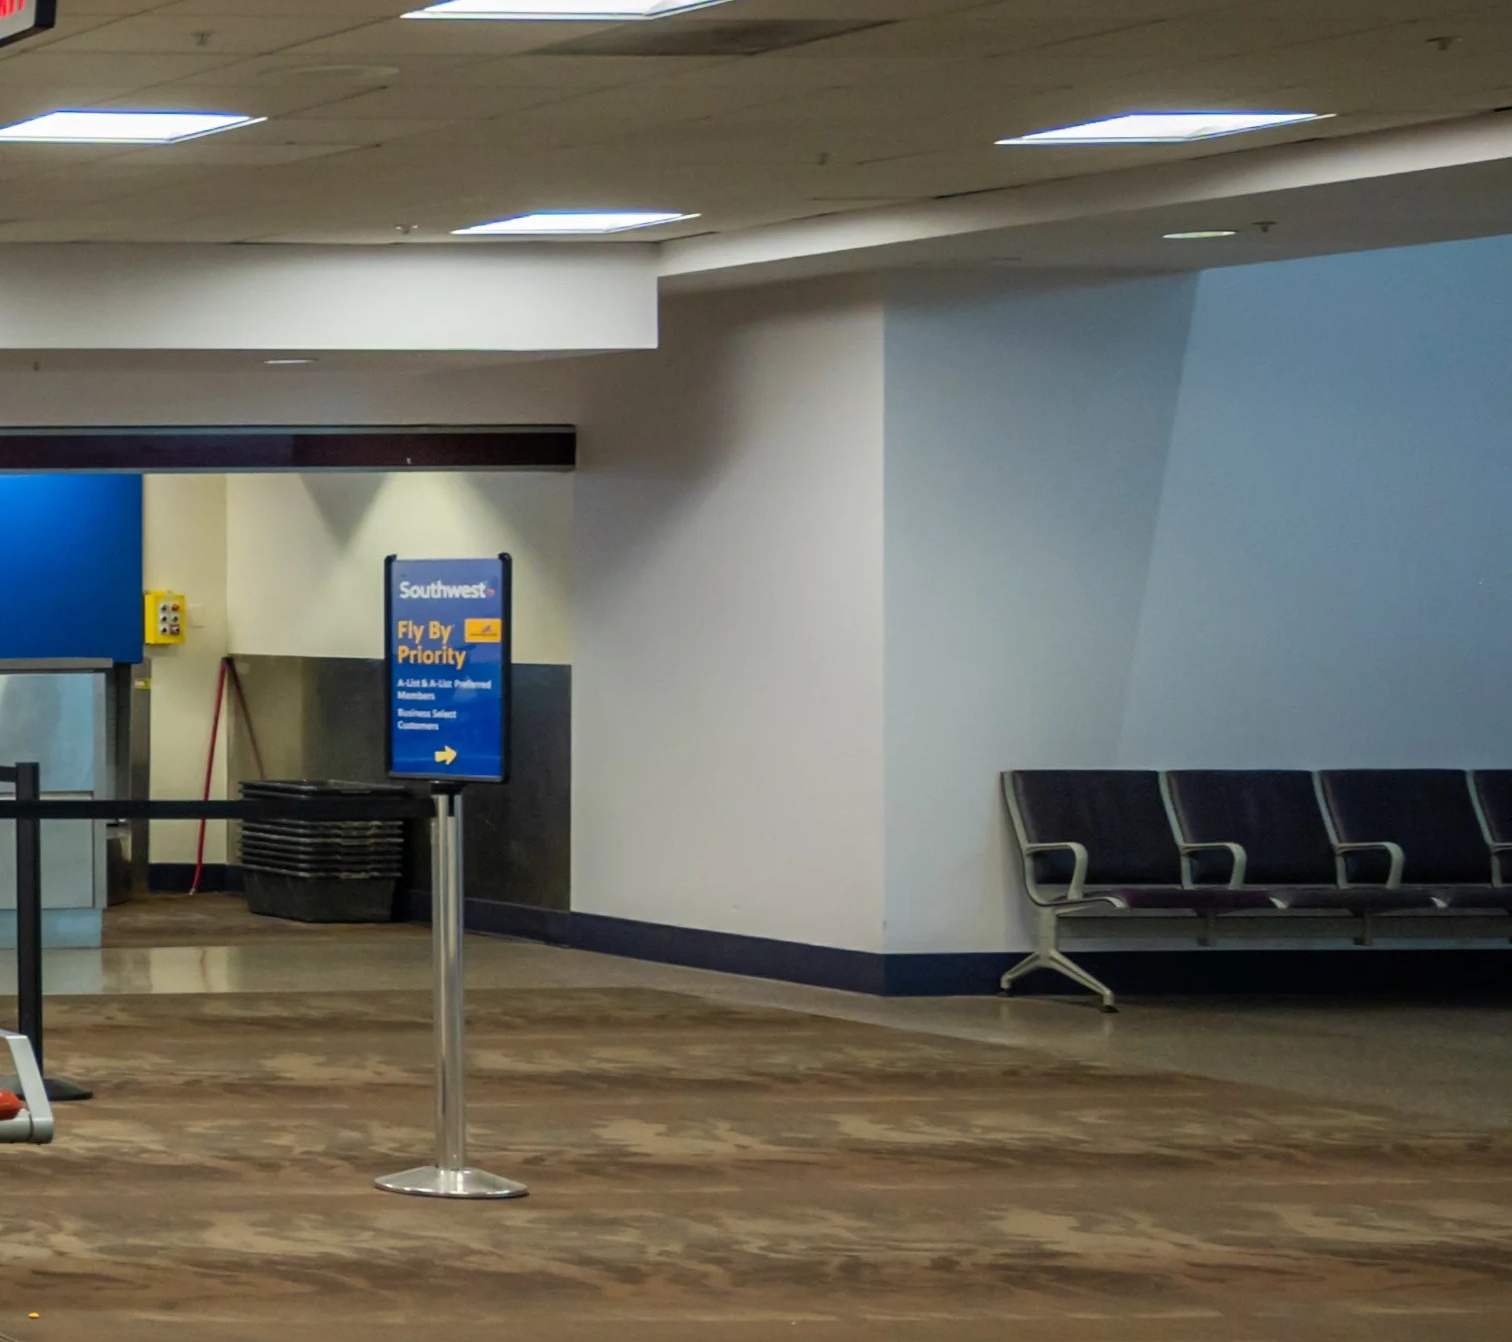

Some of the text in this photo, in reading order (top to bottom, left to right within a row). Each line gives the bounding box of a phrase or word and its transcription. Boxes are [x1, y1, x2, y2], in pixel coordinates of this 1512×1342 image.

[399, 580, 486, 598] Southwest
[397, 620, 452, 644] Fly By
[397, 645, 466, 670] Priority
